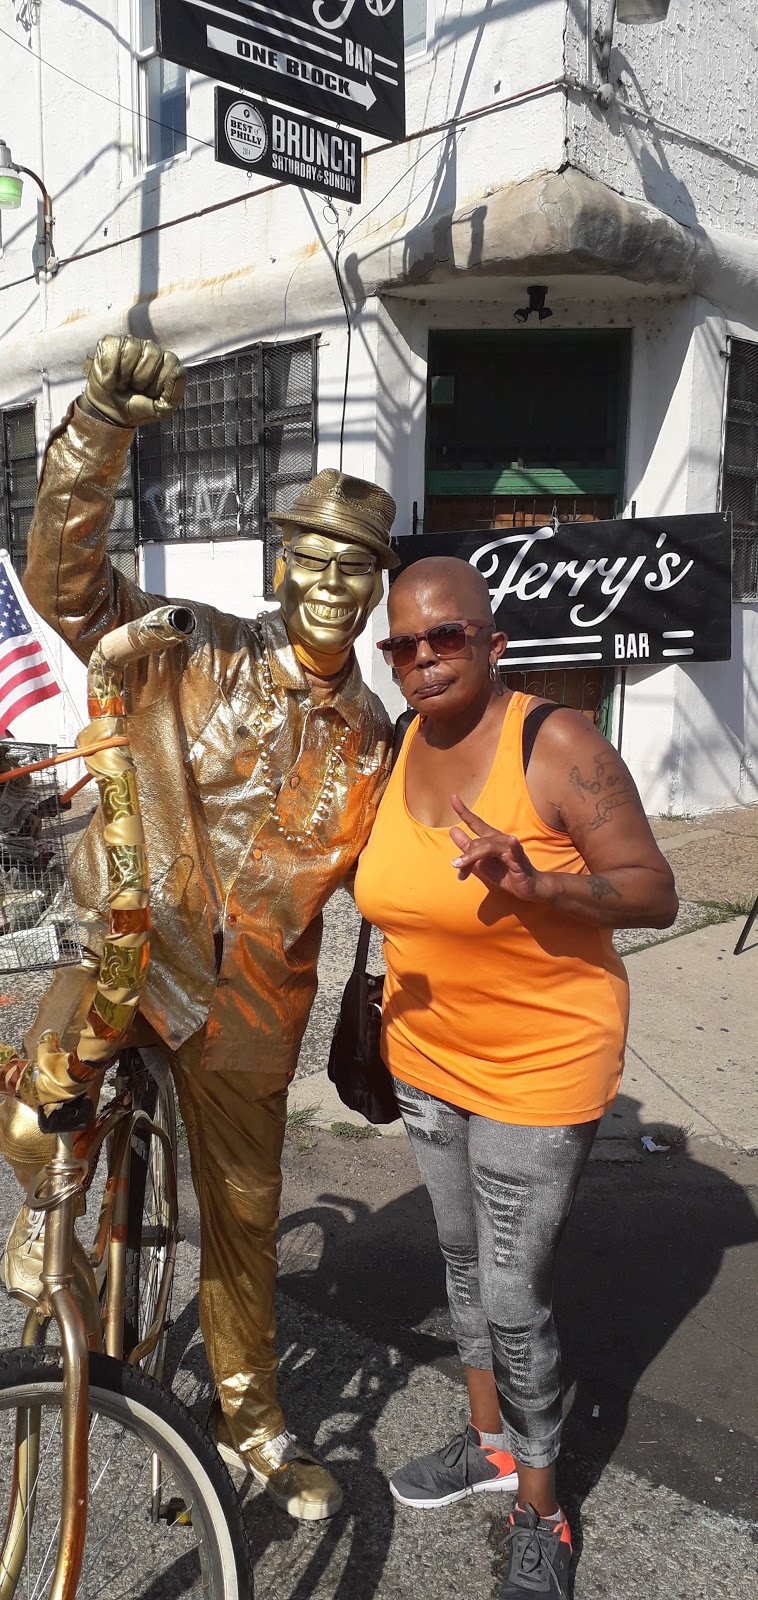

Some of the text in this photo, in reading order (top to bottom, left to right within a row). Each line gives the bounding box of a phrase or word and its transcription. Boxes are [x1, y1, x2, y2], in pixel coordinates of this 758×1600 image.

[236, 39, 351, 97] ONE BLOCK
[345, 37, 373, 76] BAR
[230, 119, 253, 134] BEST
[230, 128, 262, 146] PHILLY
[272, 113, 356, 177] BRUNCH
[272, 153, 317, 181] SATURDAY
[323, 170, 356, 194] SUNDAY
[469, 526, 695, 629] Jerry's
[614, 632, 650, 660] BAR
